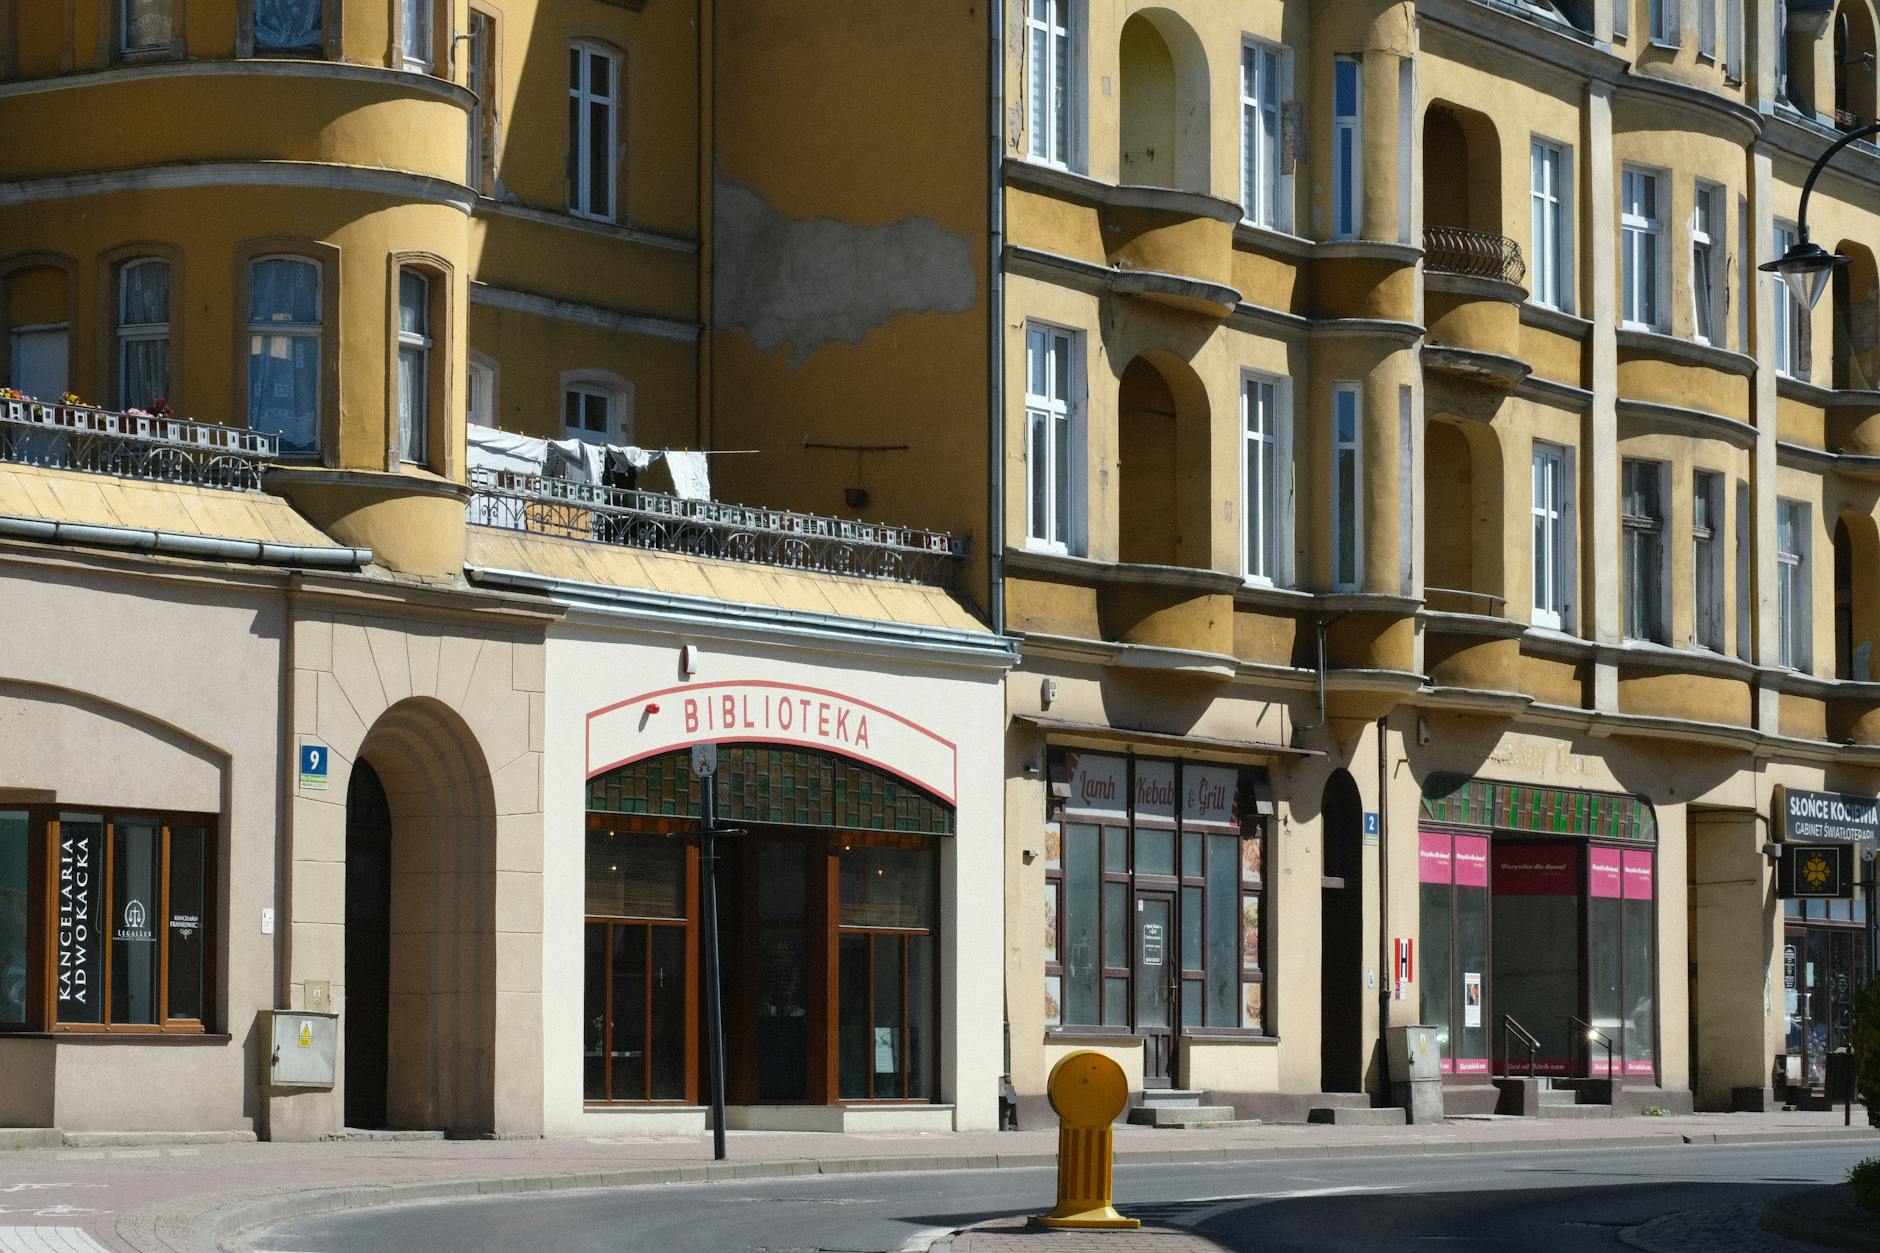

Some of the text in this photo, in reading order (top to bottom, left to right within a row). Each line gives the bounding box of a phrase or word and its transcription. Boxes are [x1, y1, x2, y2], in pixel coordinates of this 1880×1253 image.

[684, 694, 868, 750] BIBLIOTEKA
[310, 750, 320, 770] 9
[1136, 777, 1174, 806] Kebab
[1199, 778, 1226, 816] Grill
[1790, 793, 1878, 825] SŁOŃCE KOCIEWIA
[1368, 815, 1375, 831] 2
[1795, 822, 1823, 837] GABINET
[59, 838, 74, 1001] KANCELARIA
[75, 838, 89, 1004] ADWOKACKA
